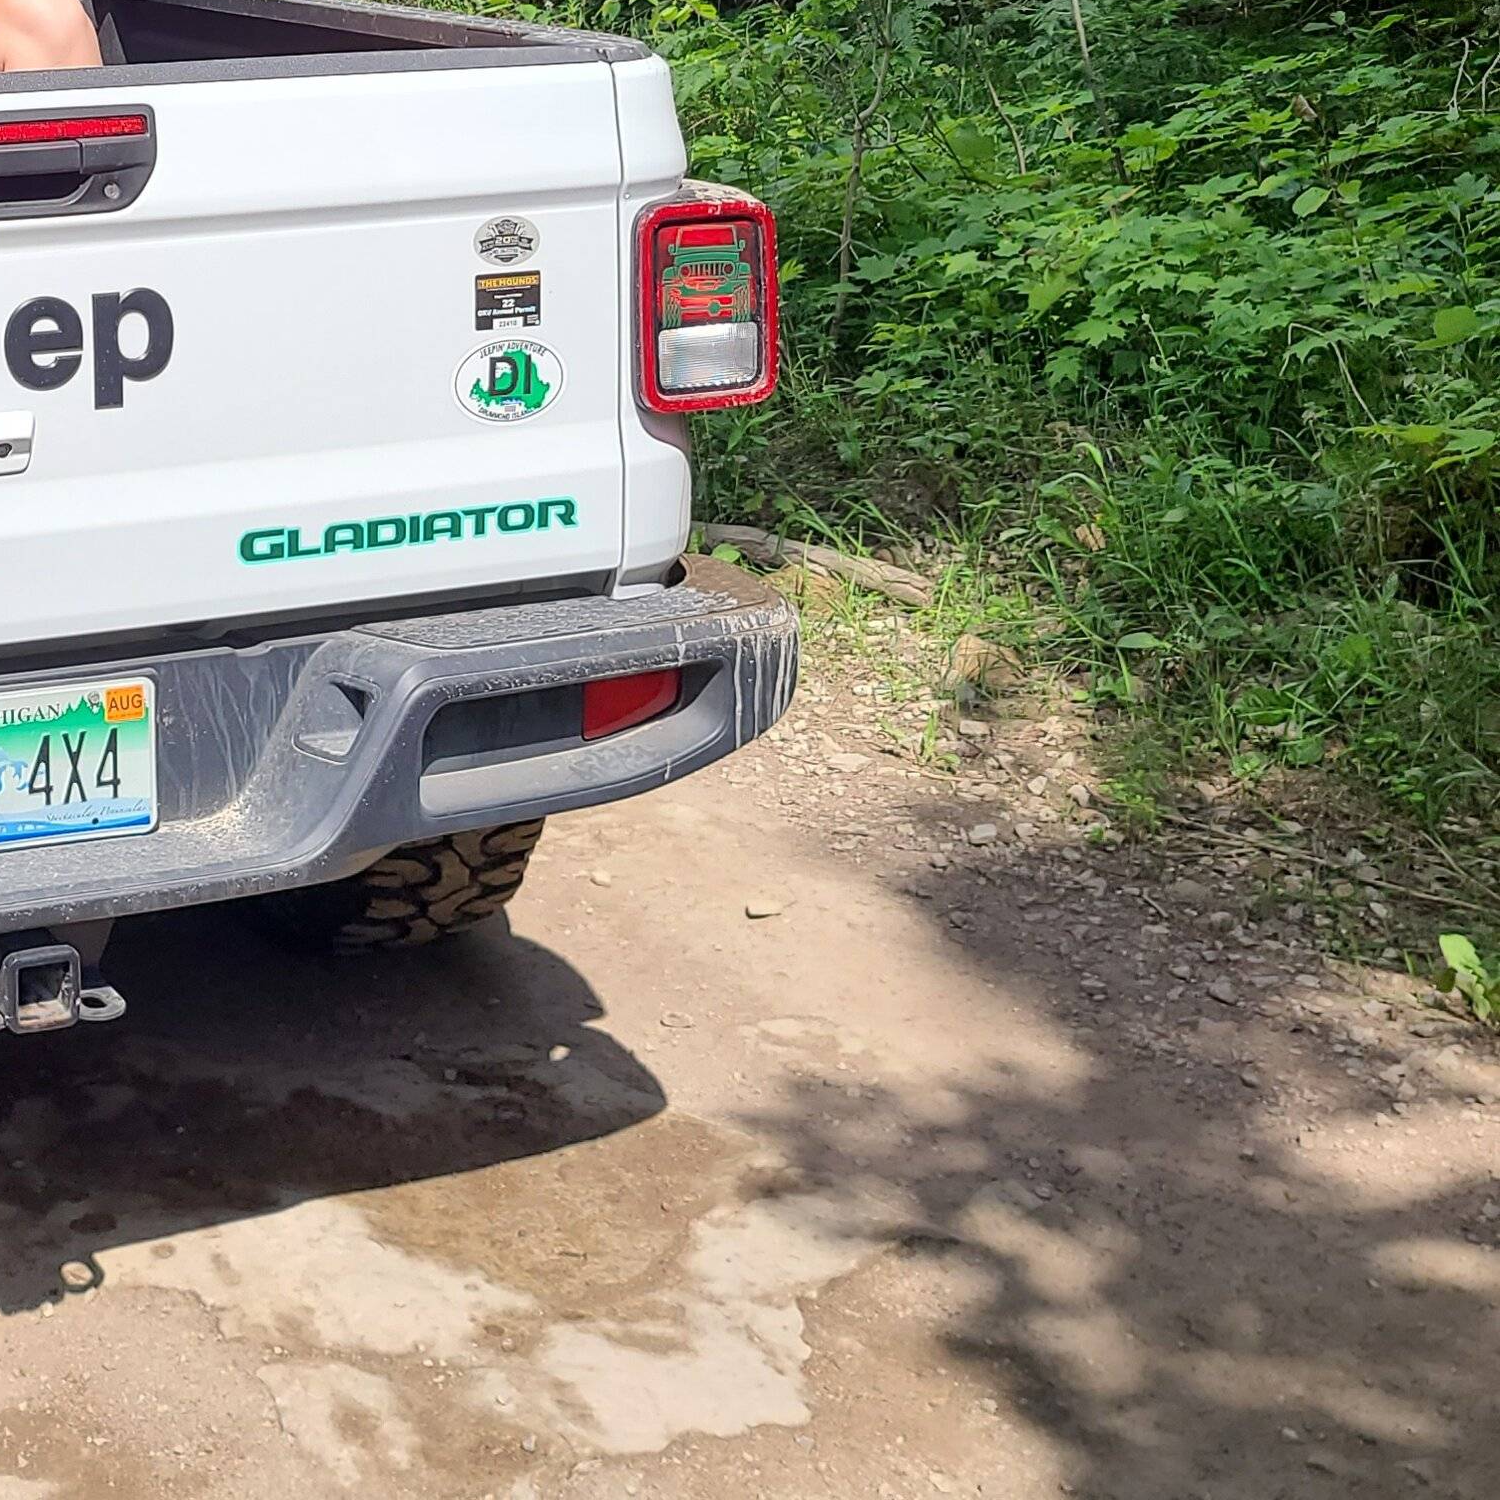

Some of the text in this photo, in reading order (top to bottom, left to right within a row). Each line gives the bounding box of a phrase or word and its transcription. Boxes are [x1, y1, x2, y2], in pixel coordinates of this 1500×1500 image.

[480, 276, 538, 288] THE MOUNDS
[501, 299, 515, 308] 22
[507, 342, 546, 357] ADVENTURE
[488, 354, 532, 397] DI
[238, 496, 580, 564] GLADIATOR
[108, 693, 143, 713] AUG
[28, 727, 121, 806] 4X4
